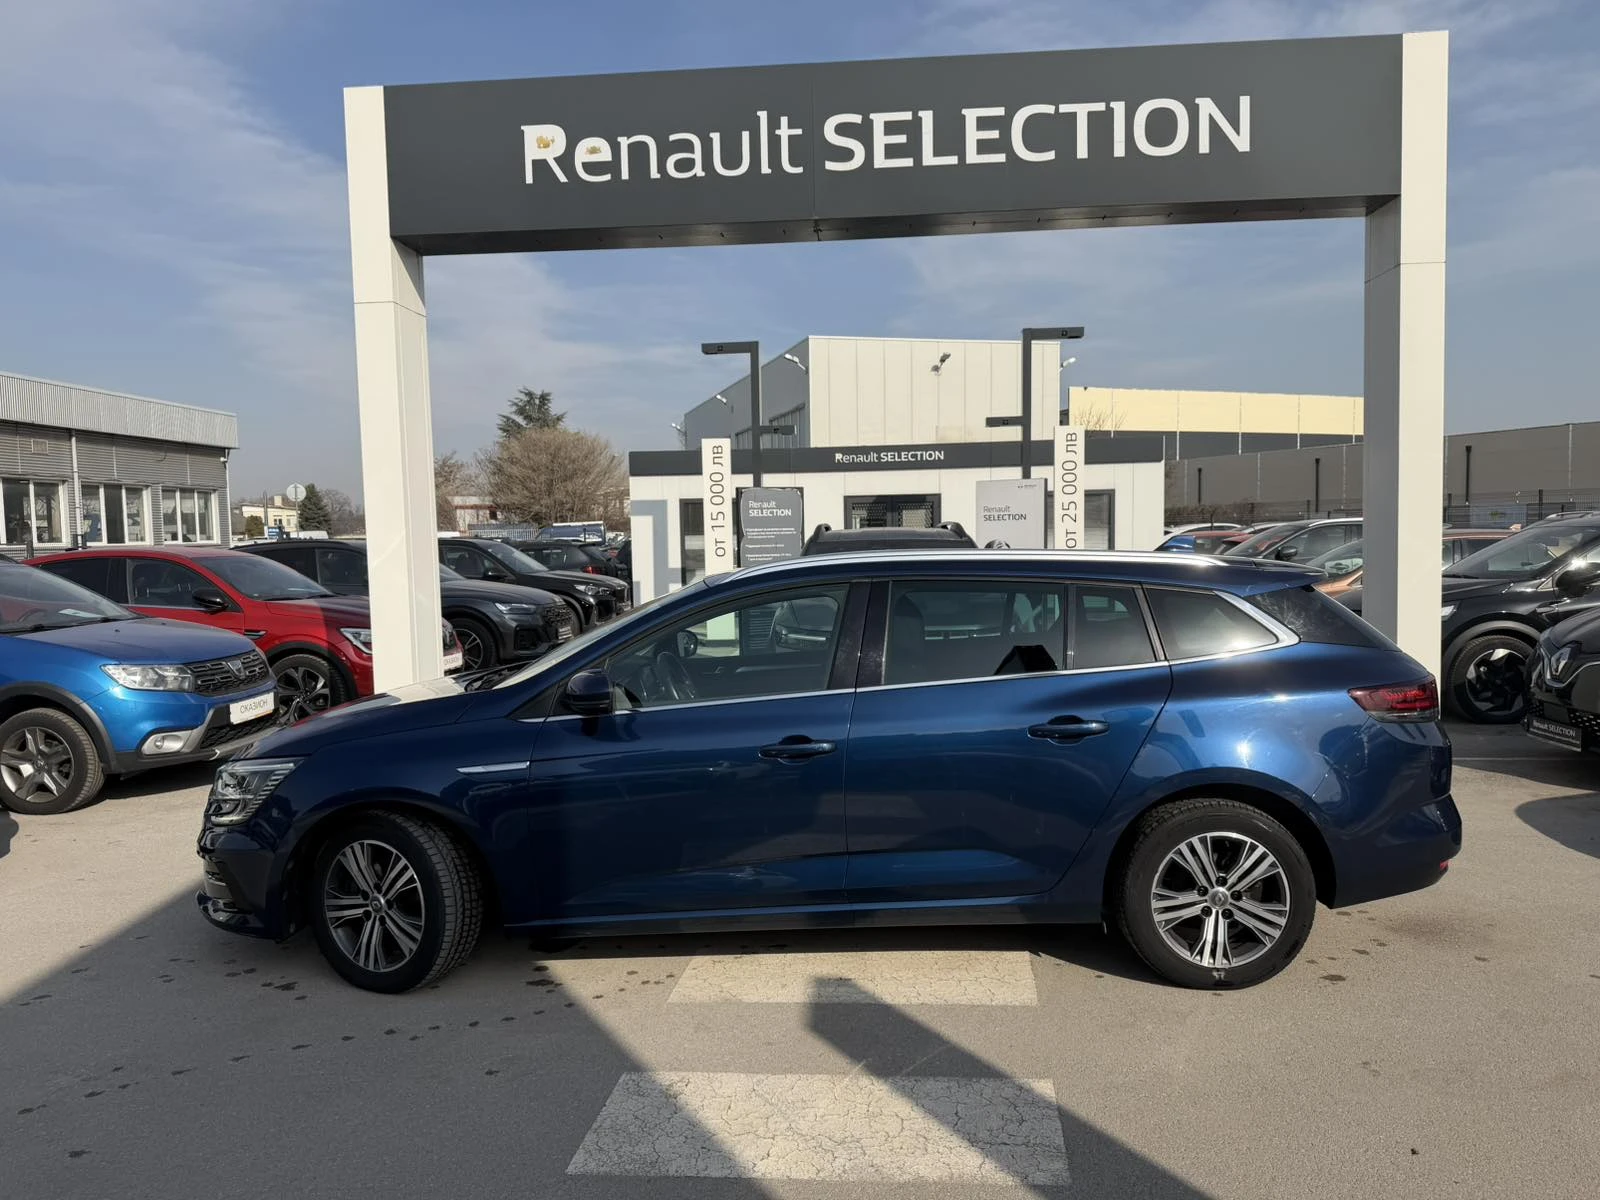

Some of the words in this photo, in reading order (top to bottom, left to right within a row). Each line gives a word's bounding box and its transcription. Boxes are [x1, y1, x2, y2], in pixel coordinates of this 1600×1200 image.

[521, 110, 804, 185] Renault
[823, 95, 1251, 172] SELECTION
[835, 452, 878, 463] Renault
[880, 450, 944, 462] SELECTION
[1061, 460, 1077, 495] 000
[709, 472, 725, 506] 000
[749, 500, 776, 508] Renault
[983, 505, 1011, 513] Renault
[1061, 501, 1077, 523] 25
[710, 511, 725, 532] 15
[983, 513, 1027, 521] SELECTION
